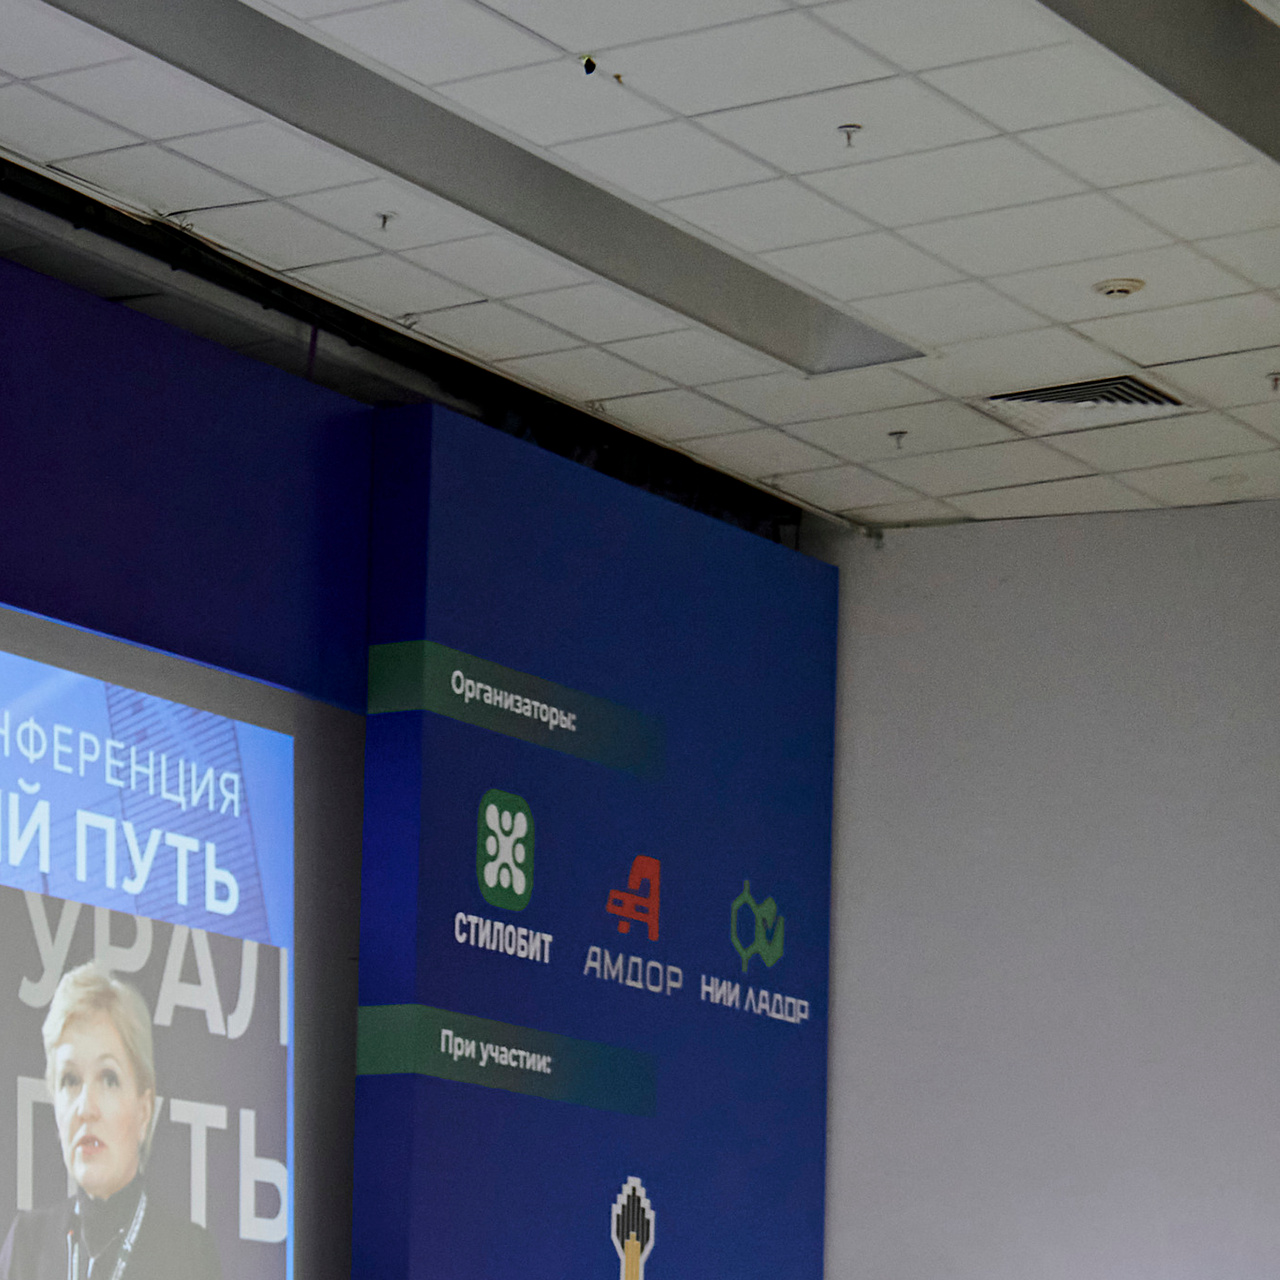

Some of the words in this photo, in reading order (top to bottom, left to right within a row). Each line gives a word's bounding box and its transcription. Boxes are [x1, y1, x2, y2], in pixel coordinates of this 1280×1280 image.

[451, 670, 577, 732] Организаторы:
[75, 806, 239, 916] ПУТЬ
[454, 912, 554, 964] СТИЛОБИТ
[583, 946, 683, 996] АМДОР
[701, 974, 741, 1010] НИИ
[744, 987, 810, 1025] ЛАДОР
[441, 1029, 476, 1060] При
[480, 1037, 552, 1075] участии:
